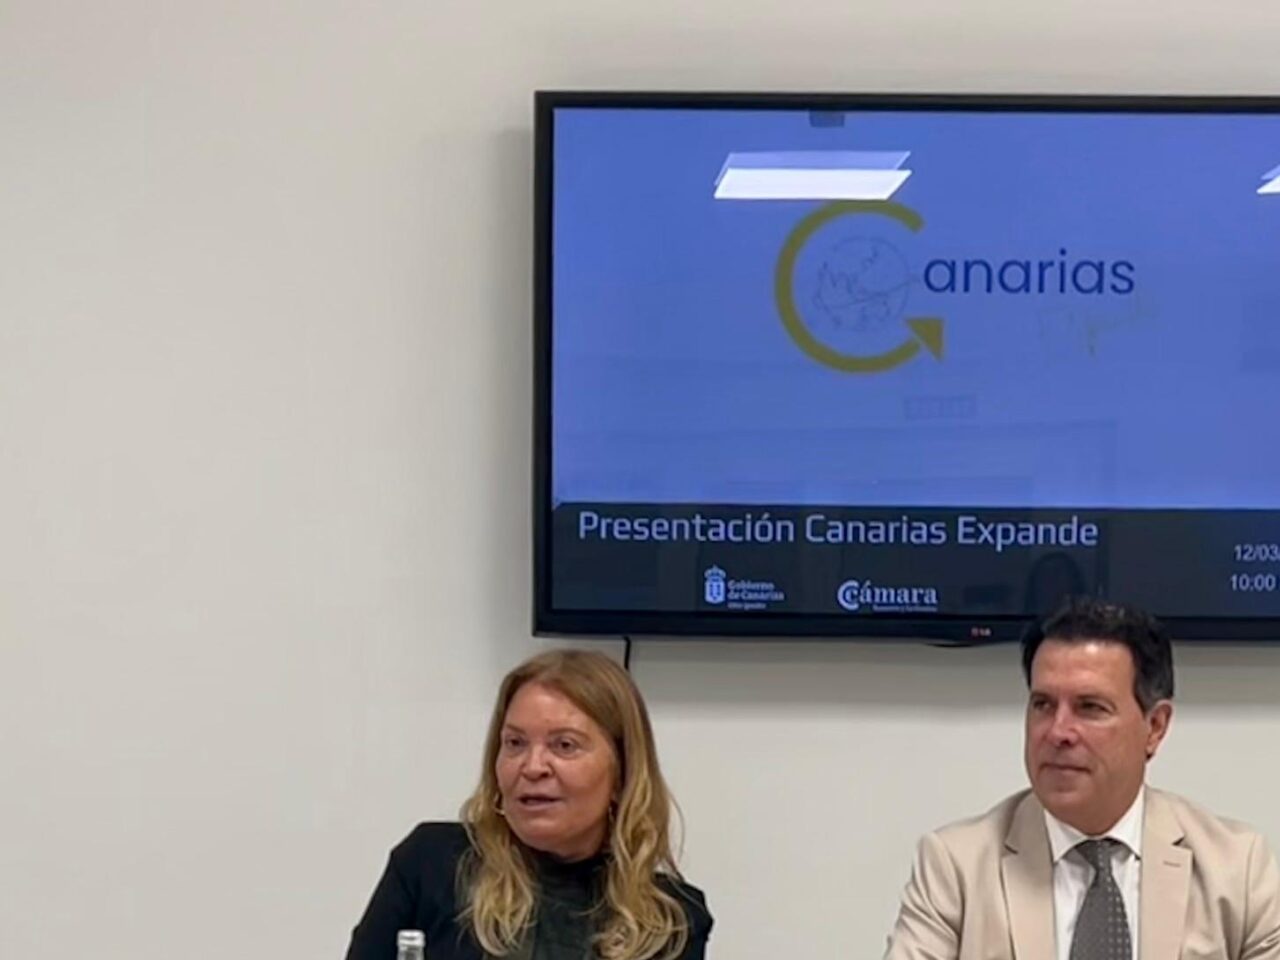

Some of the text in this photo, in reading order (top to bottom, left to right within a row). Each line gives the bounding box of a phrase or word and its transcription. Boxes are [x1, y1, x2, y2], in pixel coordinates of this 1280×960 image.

[578, 511, 1099, 552] Presentación Canarias Expande
[1230, 574, 1276, 591] 10:00
